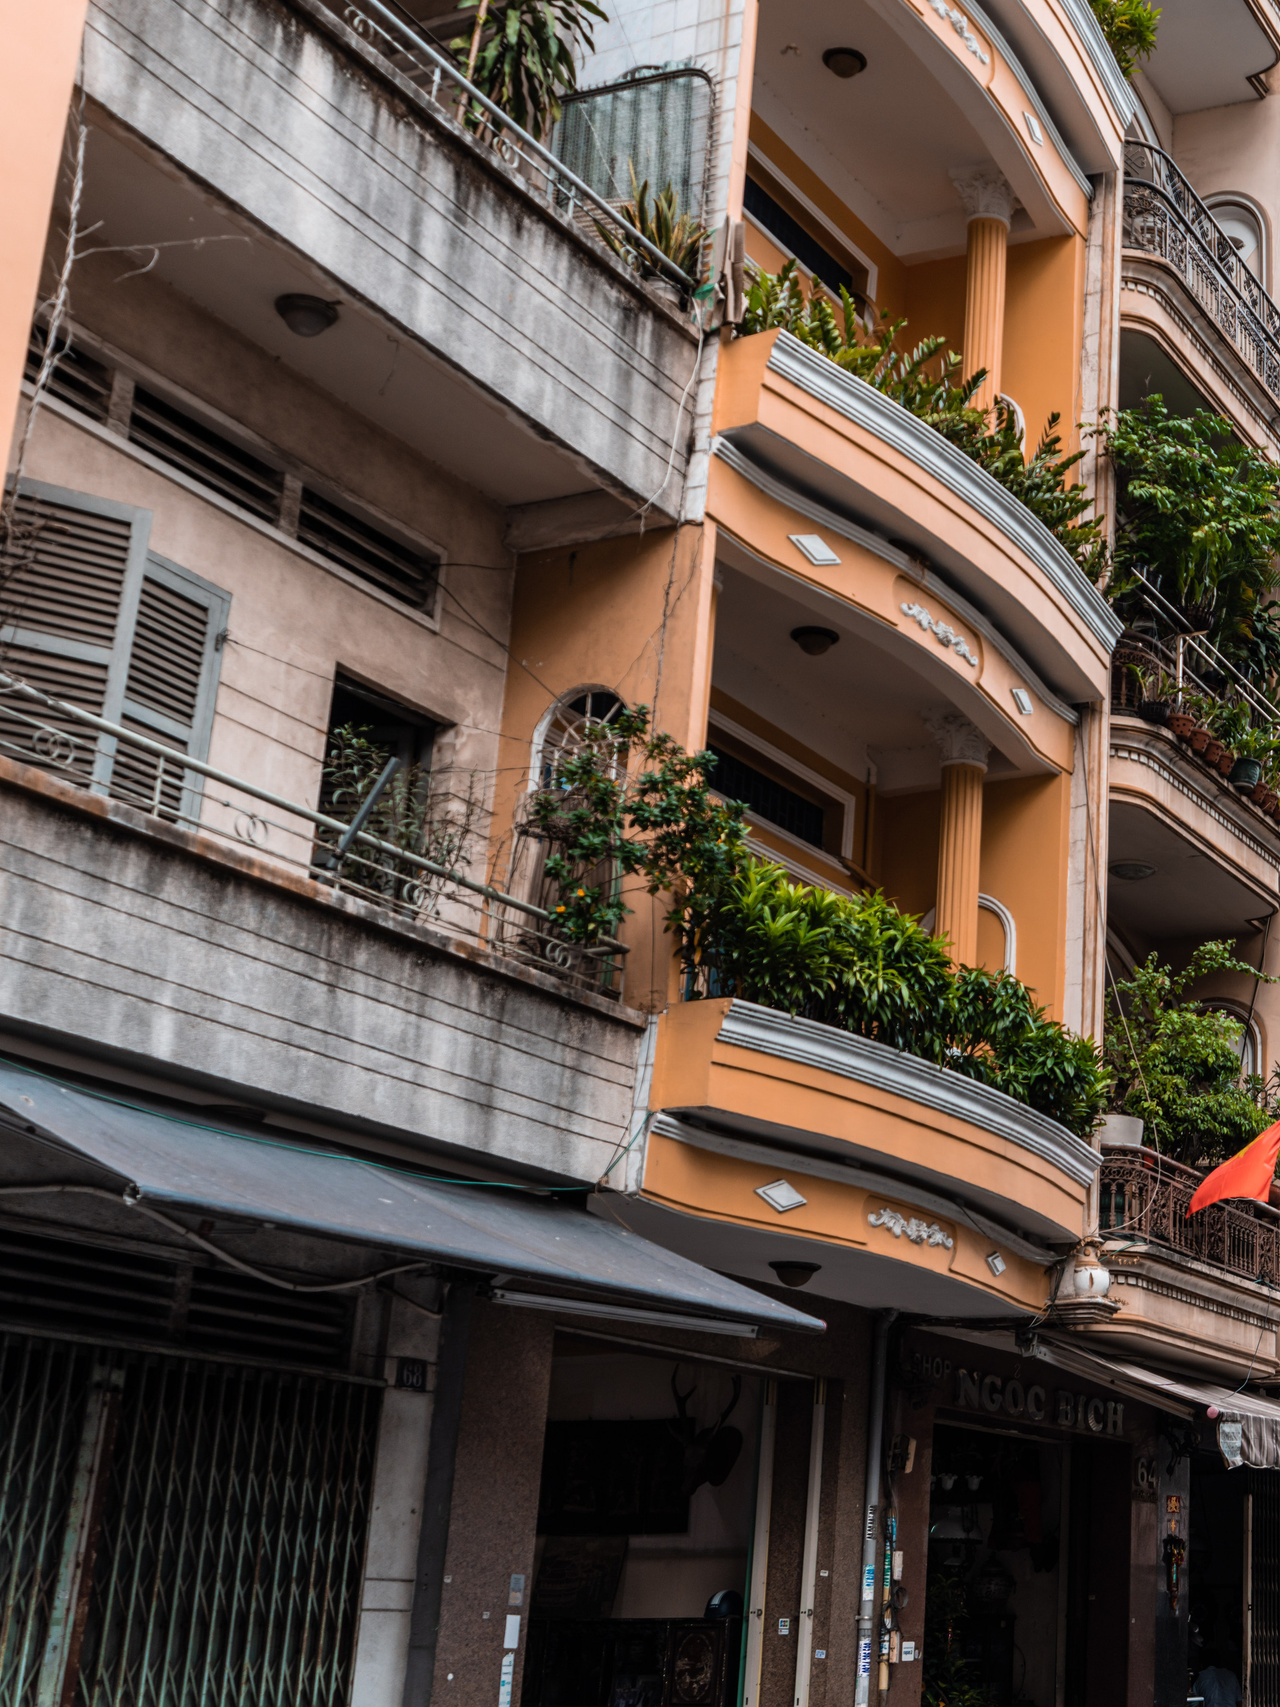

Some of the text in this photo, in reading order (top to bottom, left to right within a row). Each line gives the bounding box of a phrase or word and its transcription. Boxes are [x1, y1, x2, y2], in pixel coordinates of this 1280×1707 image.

[402, 1363, 423, 1388] 68
[912, 1353, 952, 1380] SHOP
[1137, 1457, 1158, 1489] 64
